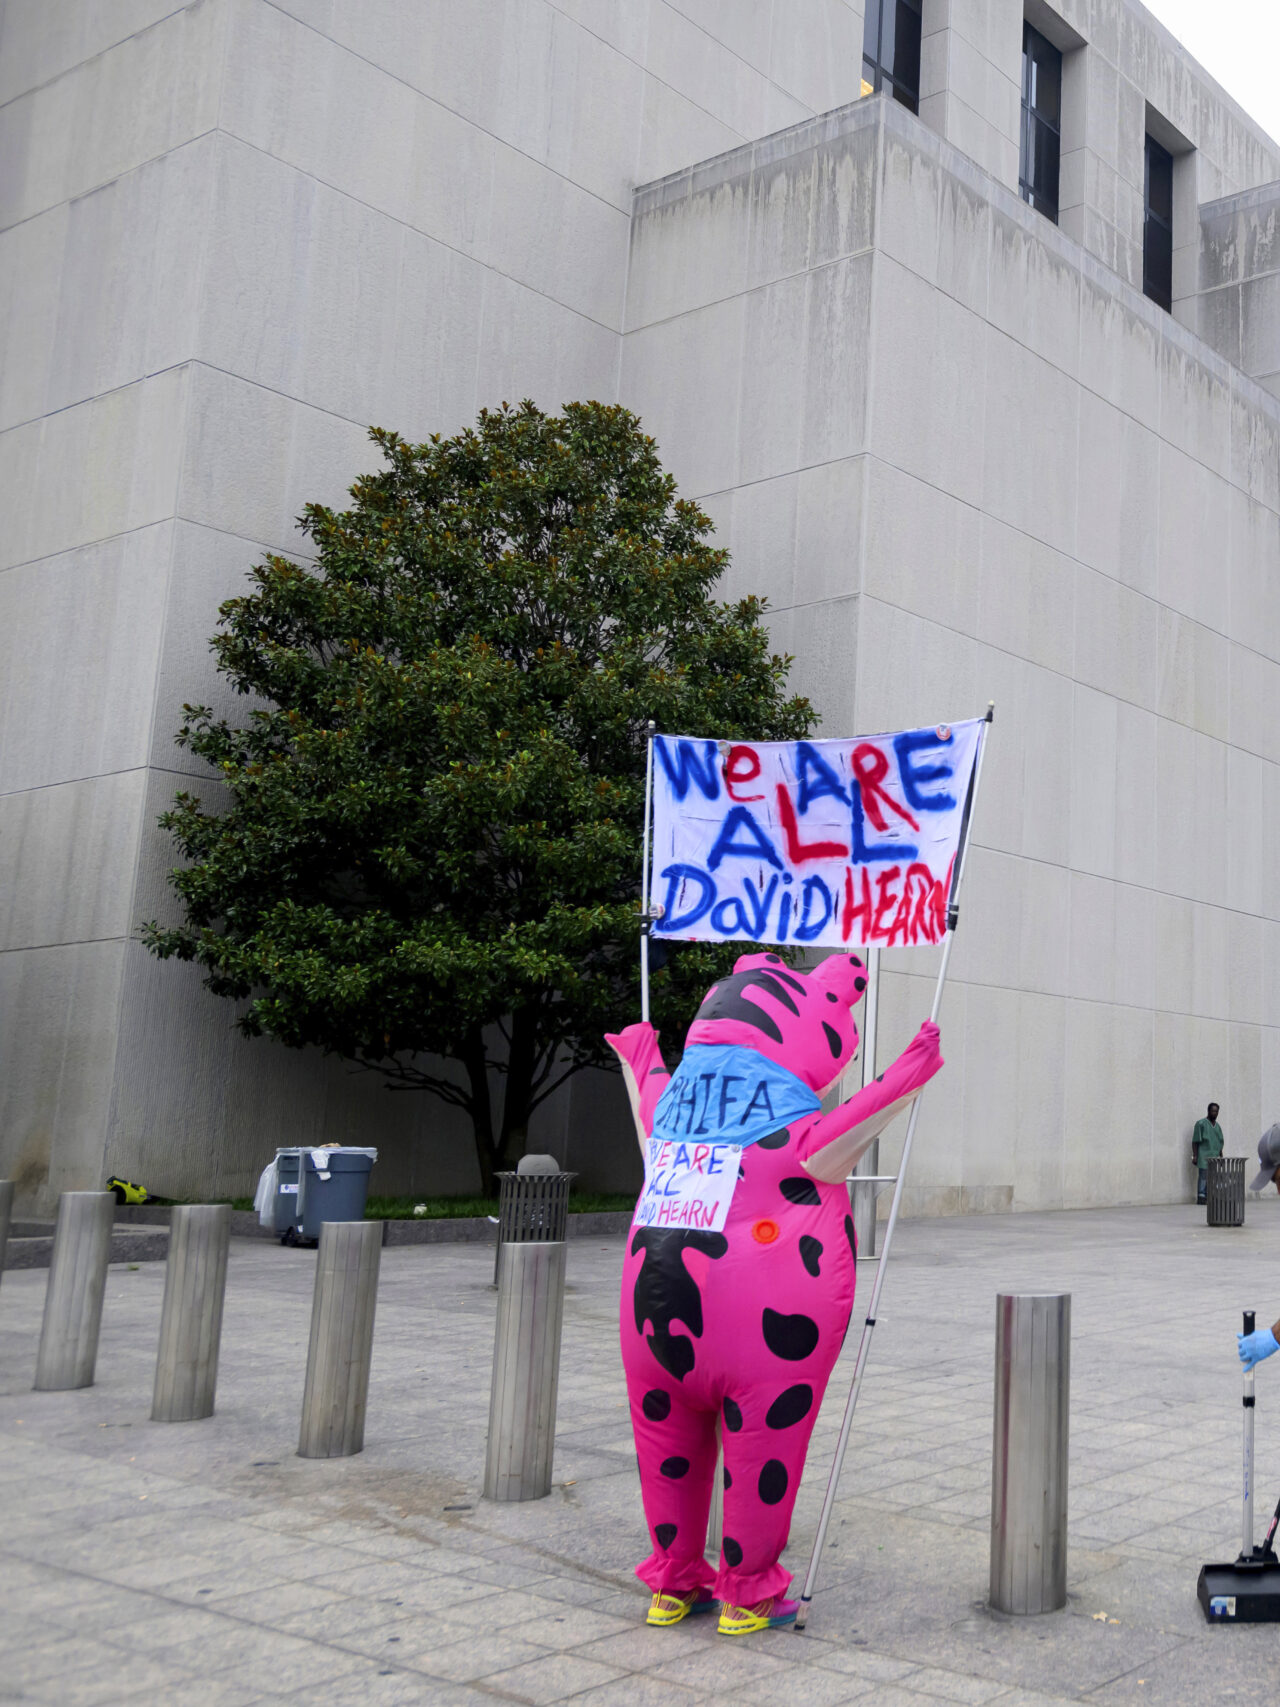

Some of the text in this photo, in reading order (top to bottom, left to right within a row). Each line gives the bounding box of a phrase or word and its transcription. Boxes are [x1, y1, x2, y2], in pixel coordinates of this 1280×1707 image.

[654, 731, 957, 832] We ARE
[706, 777, 919, 872] ALL
[842, 851, 958, 947] HEARN
[646, 1168, 681, 1197] ALL
[672, 1143, 729, 1175] ARE
[657, 1200, 720, 1228] HEARN
